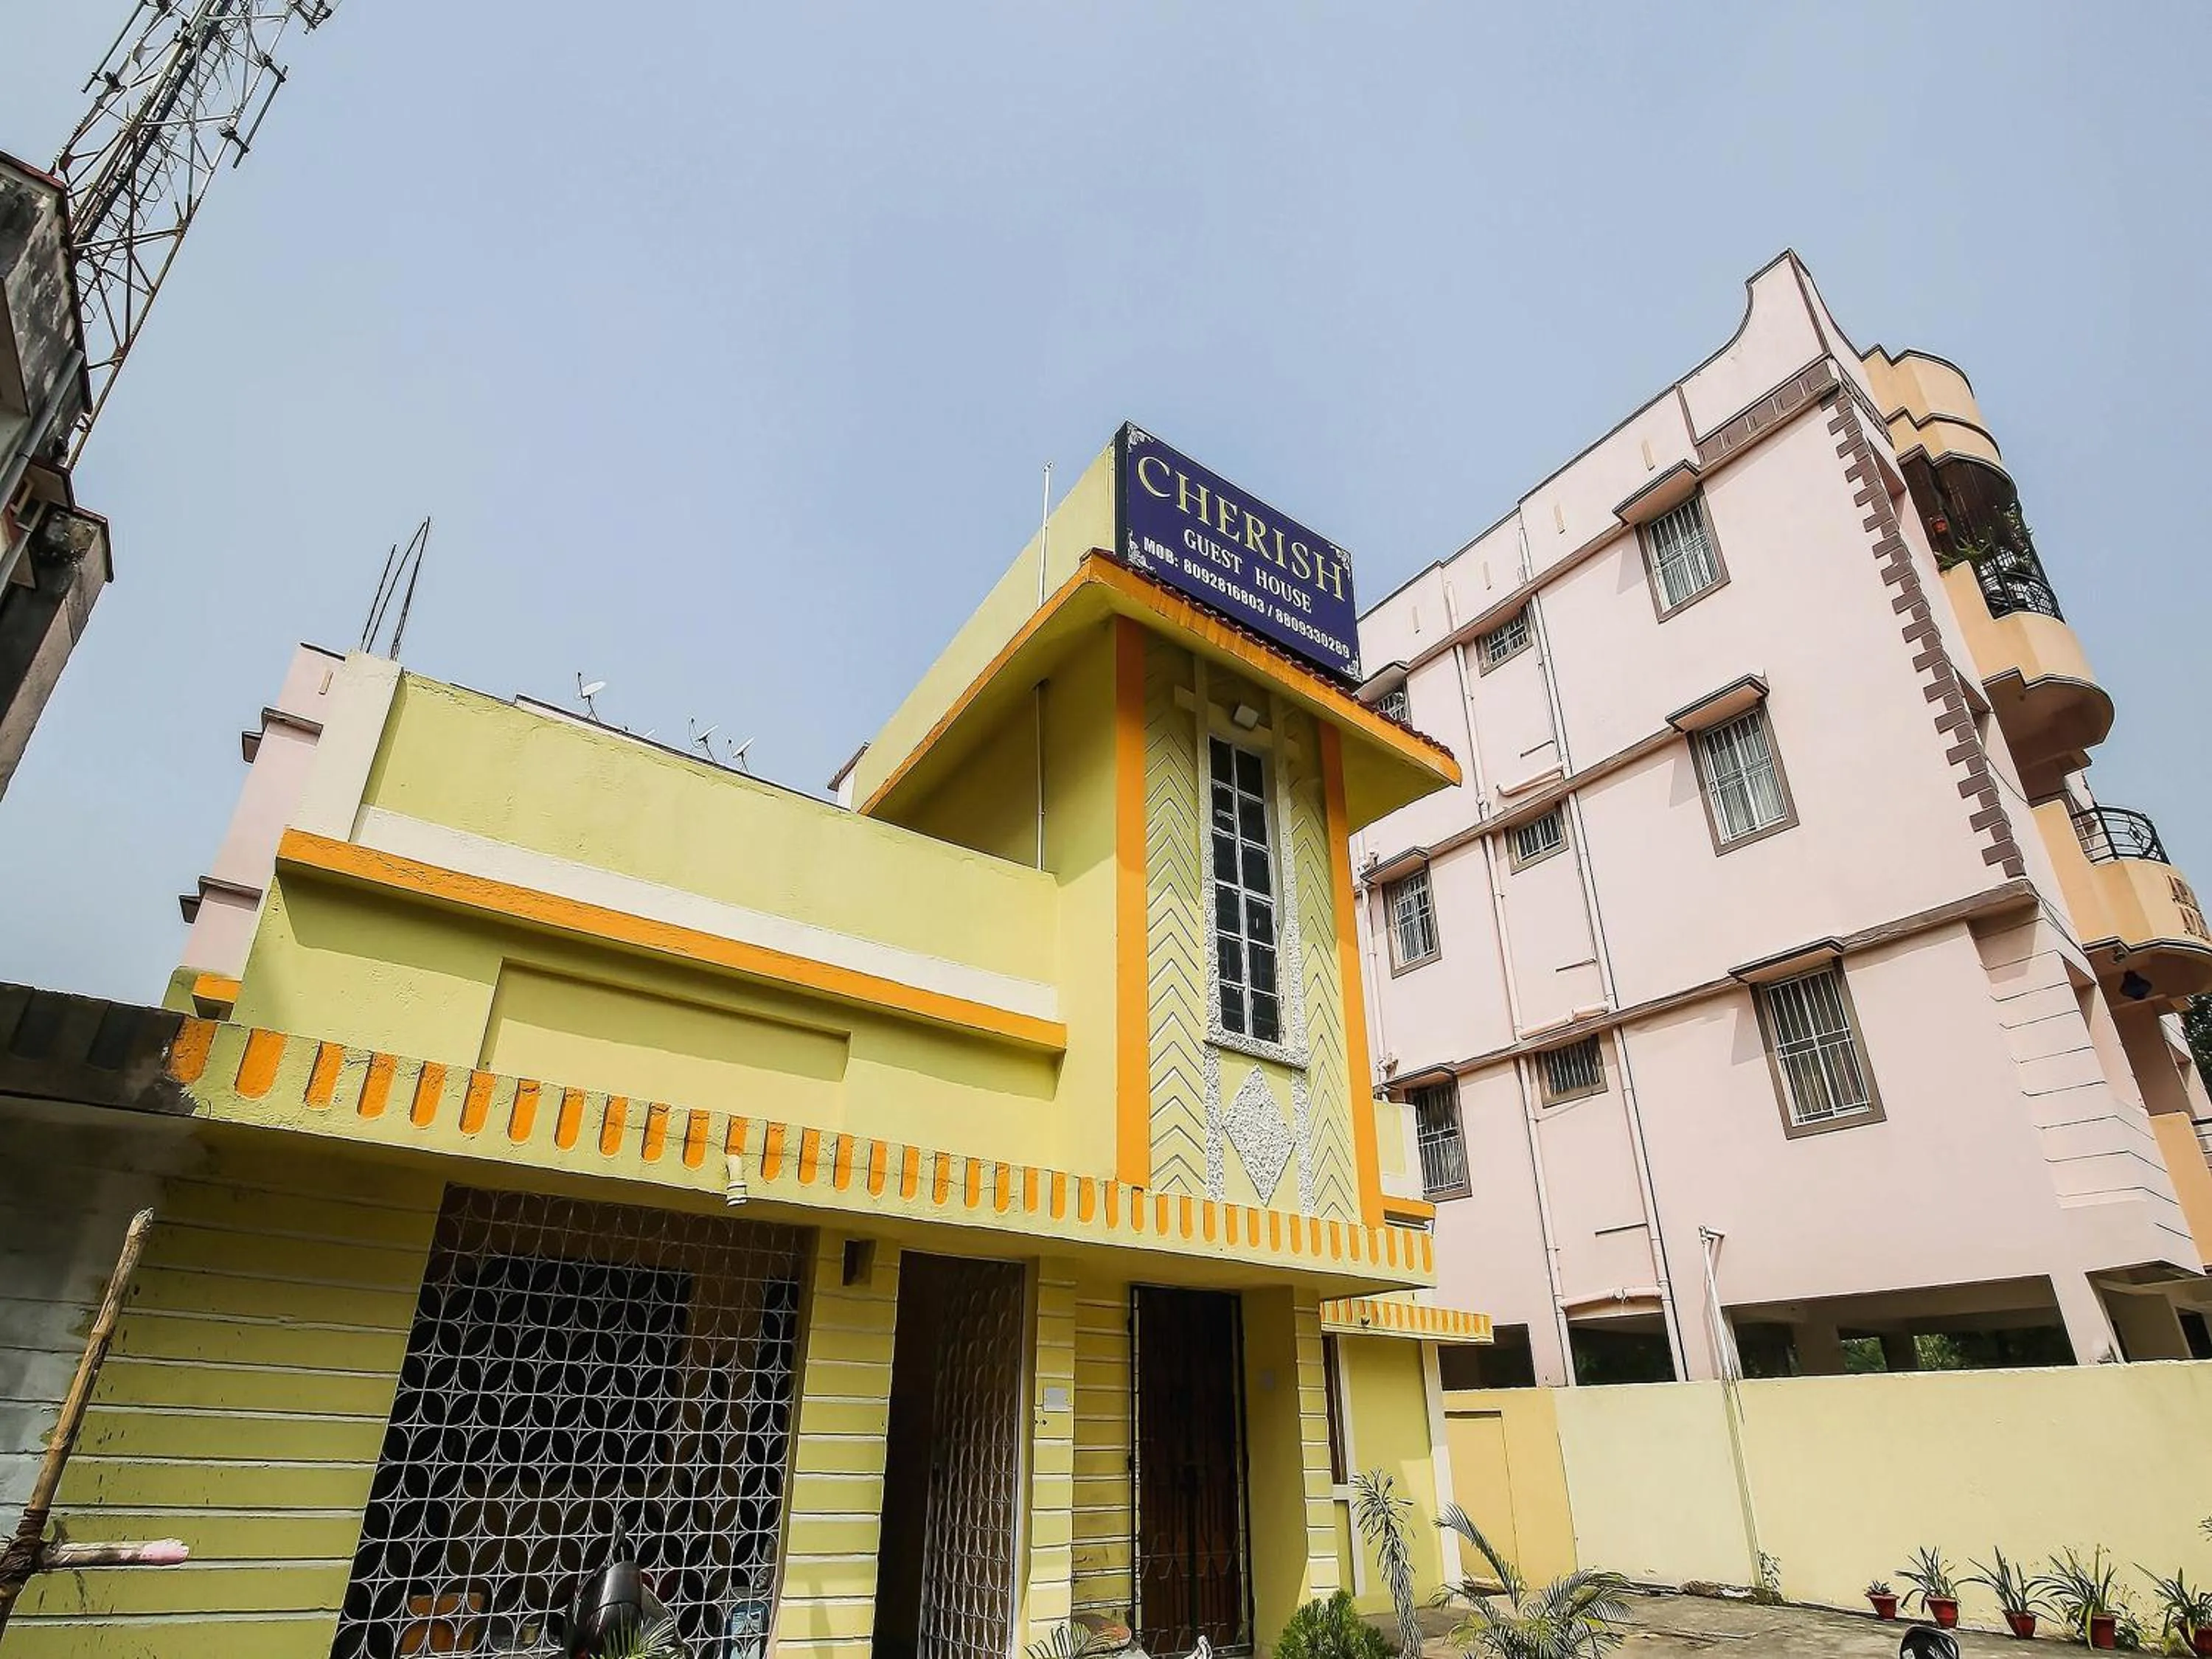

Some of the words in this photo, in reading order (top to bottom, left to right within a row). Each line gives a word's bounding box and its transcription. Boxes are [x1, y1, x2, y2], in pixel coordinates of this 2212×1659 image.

[1137, 456, 1346, 602] CHERISH
[1183, 529, 1243, 575] GUEST
[1254, 566, 1312, 614] HOUSE
[1143, 536, 1179, 568] MOB:
[1183, 557, 1265, 613] 8092816803
